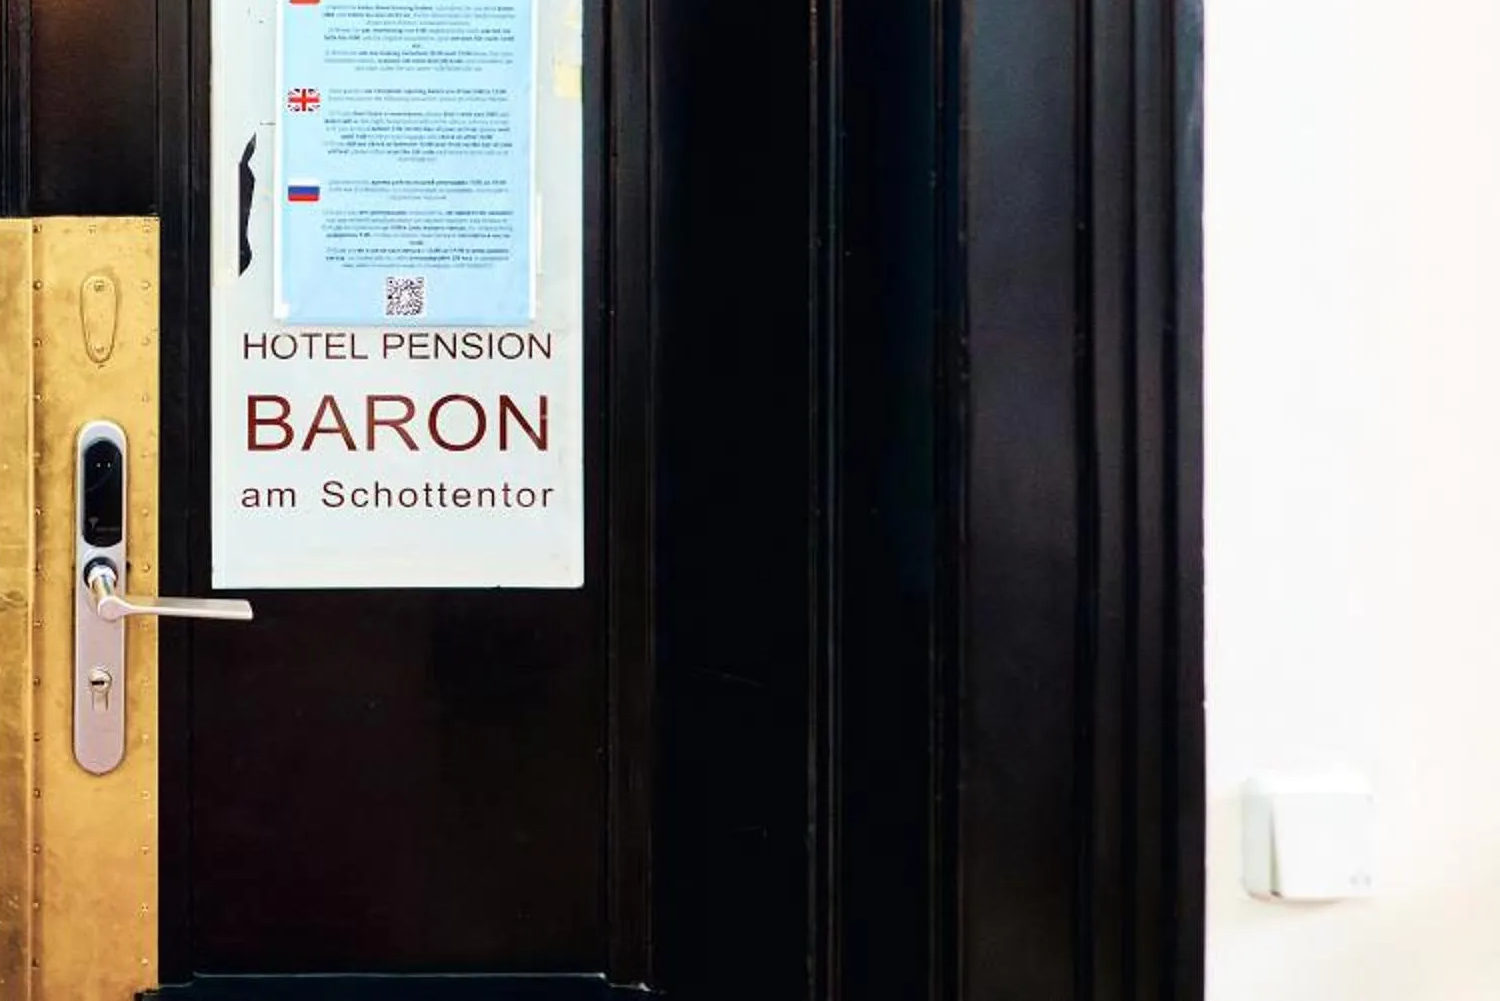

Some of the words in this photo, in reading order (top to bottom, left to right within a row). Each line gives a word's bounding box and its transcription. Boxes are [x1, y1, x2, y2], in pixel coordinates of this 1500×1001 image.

[243, 332, 369, 360] HOTEL
[382, 332, 552, 360] PENSION
[247, 394, 549, 452] BARON
[241, 487, 297, 509] am
[321, 480, 555, 509] Schottentor
